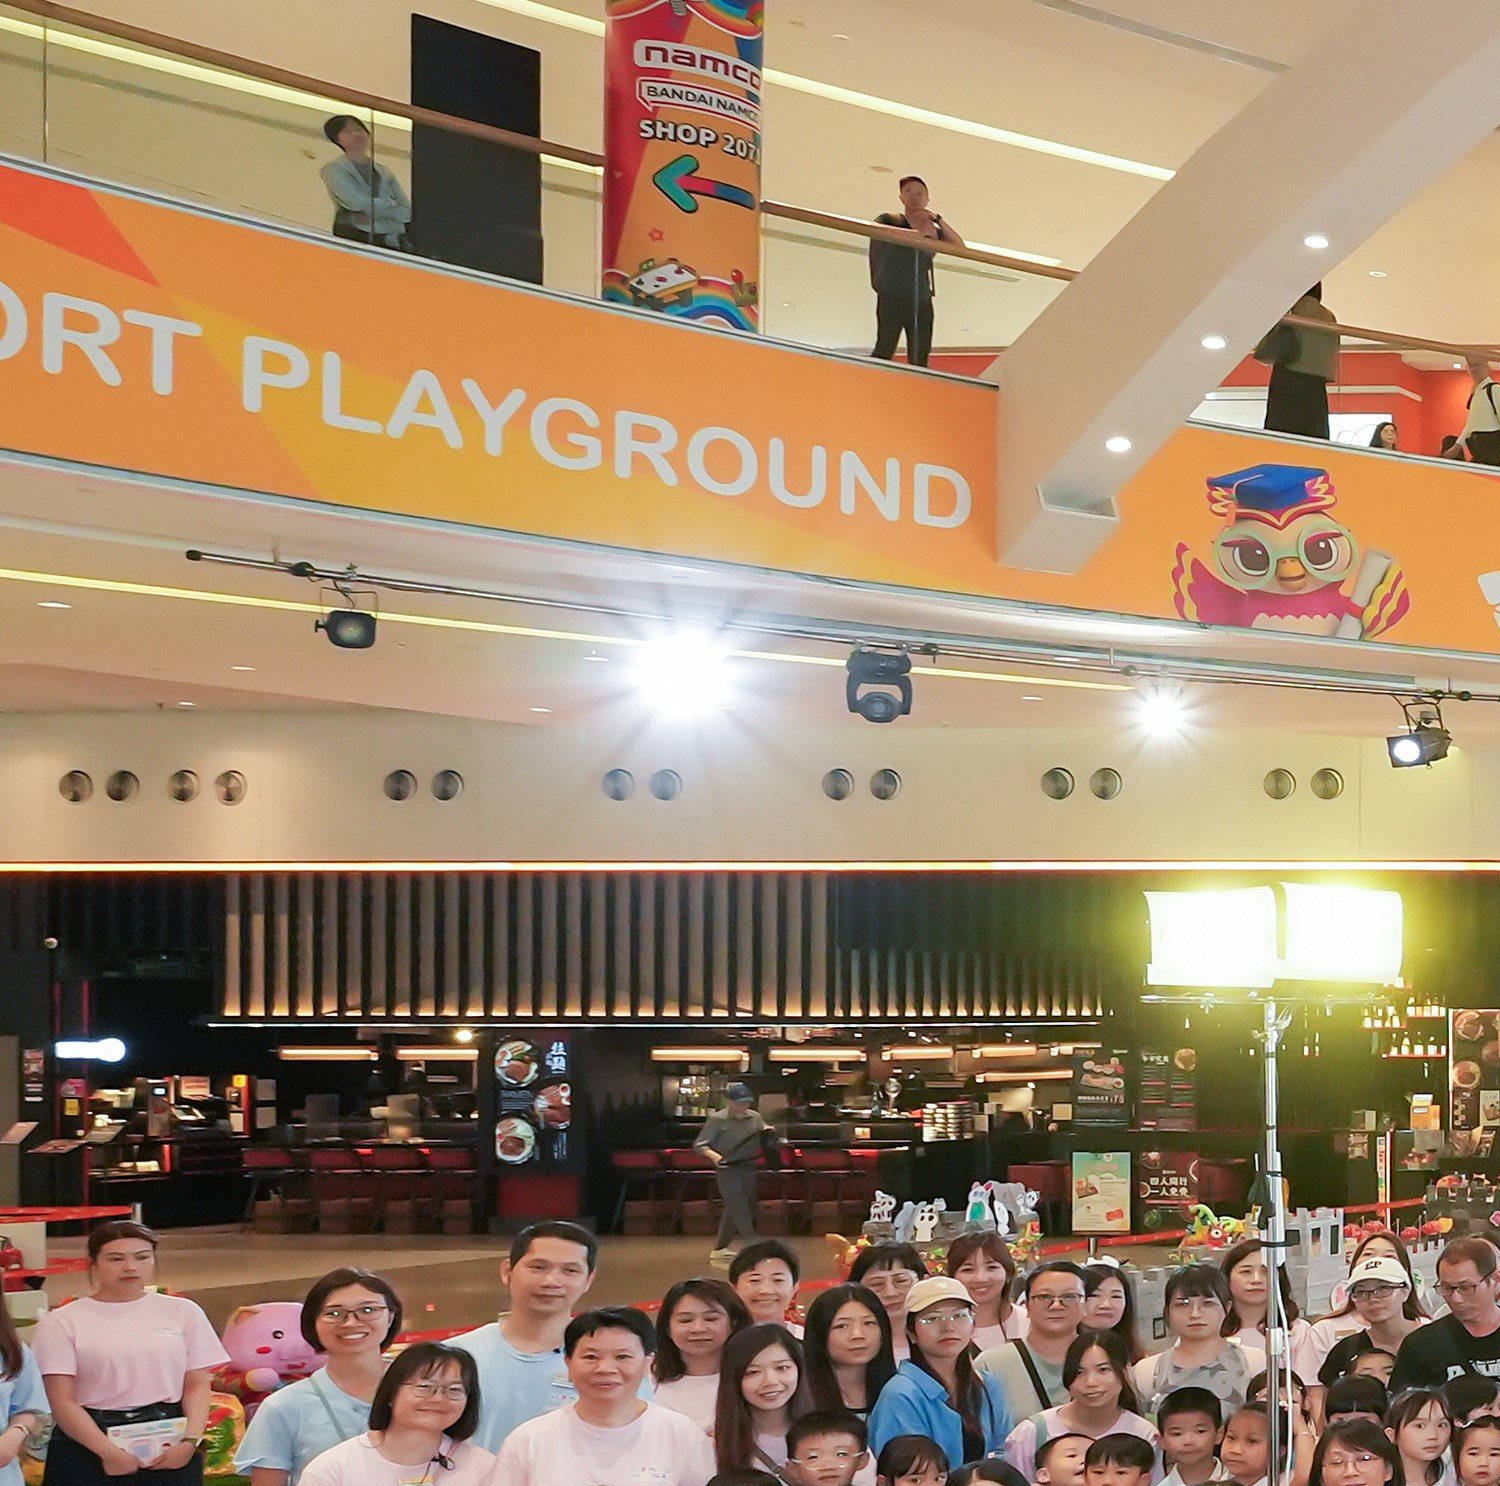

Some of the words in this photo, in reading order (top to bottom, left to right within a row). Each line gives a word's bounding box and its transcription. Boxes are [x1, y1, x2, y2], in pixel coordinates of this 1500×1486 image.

[647, 86, 713, 107] BANDAI
[639, 119, 717, 148] SHOP
[242, 336, 973, 530] PLAYGROUND
